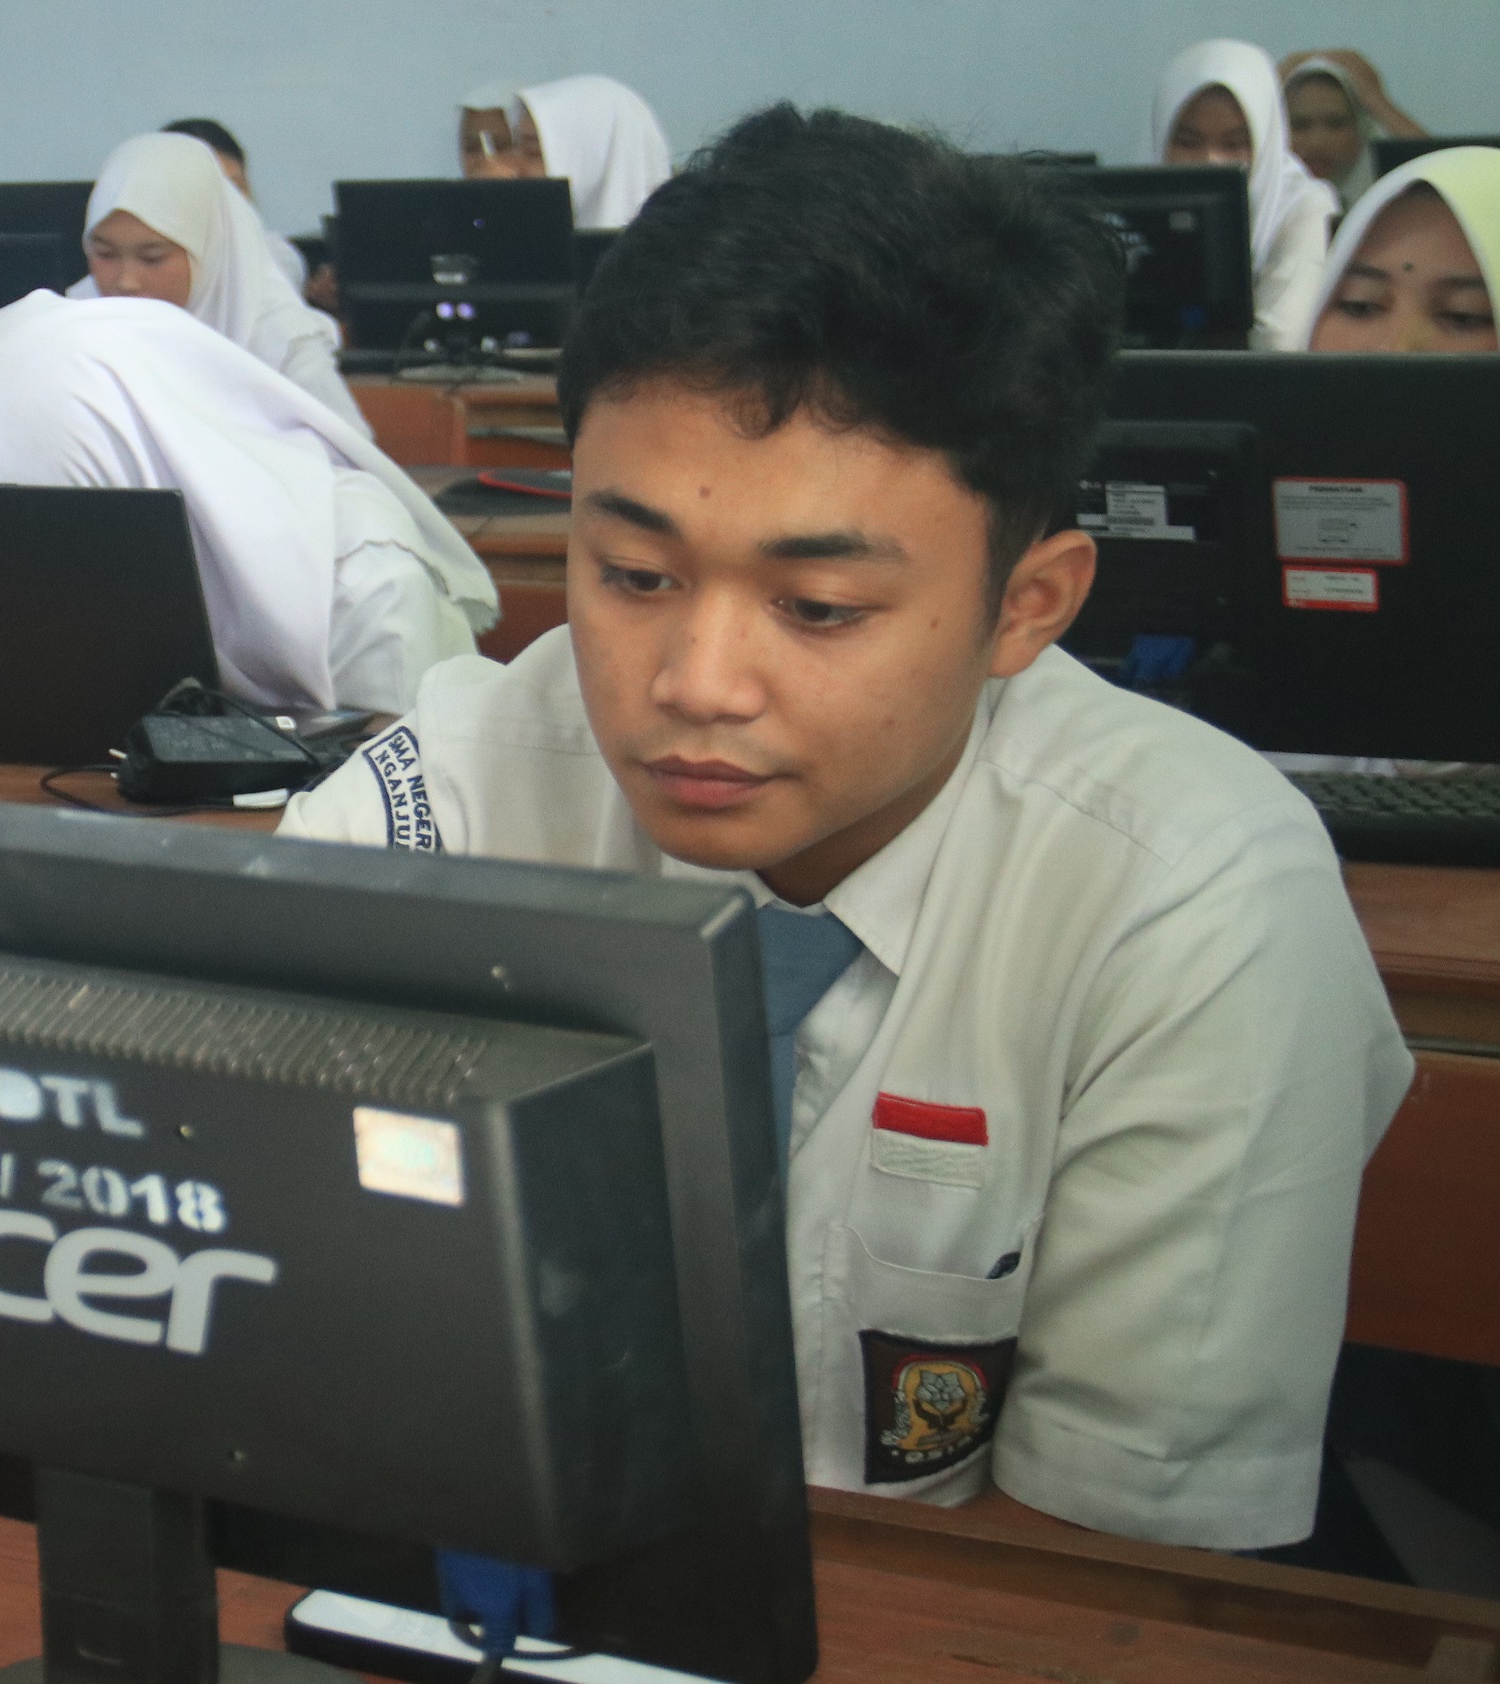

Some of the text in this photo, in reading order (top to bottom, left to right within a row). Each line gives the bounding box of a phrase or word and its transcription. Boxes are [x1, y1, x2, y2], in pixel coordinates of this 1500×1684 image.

[388, 735, 432, 851] SMA NEGER
[37, 1160, 227, 1234] 2018
